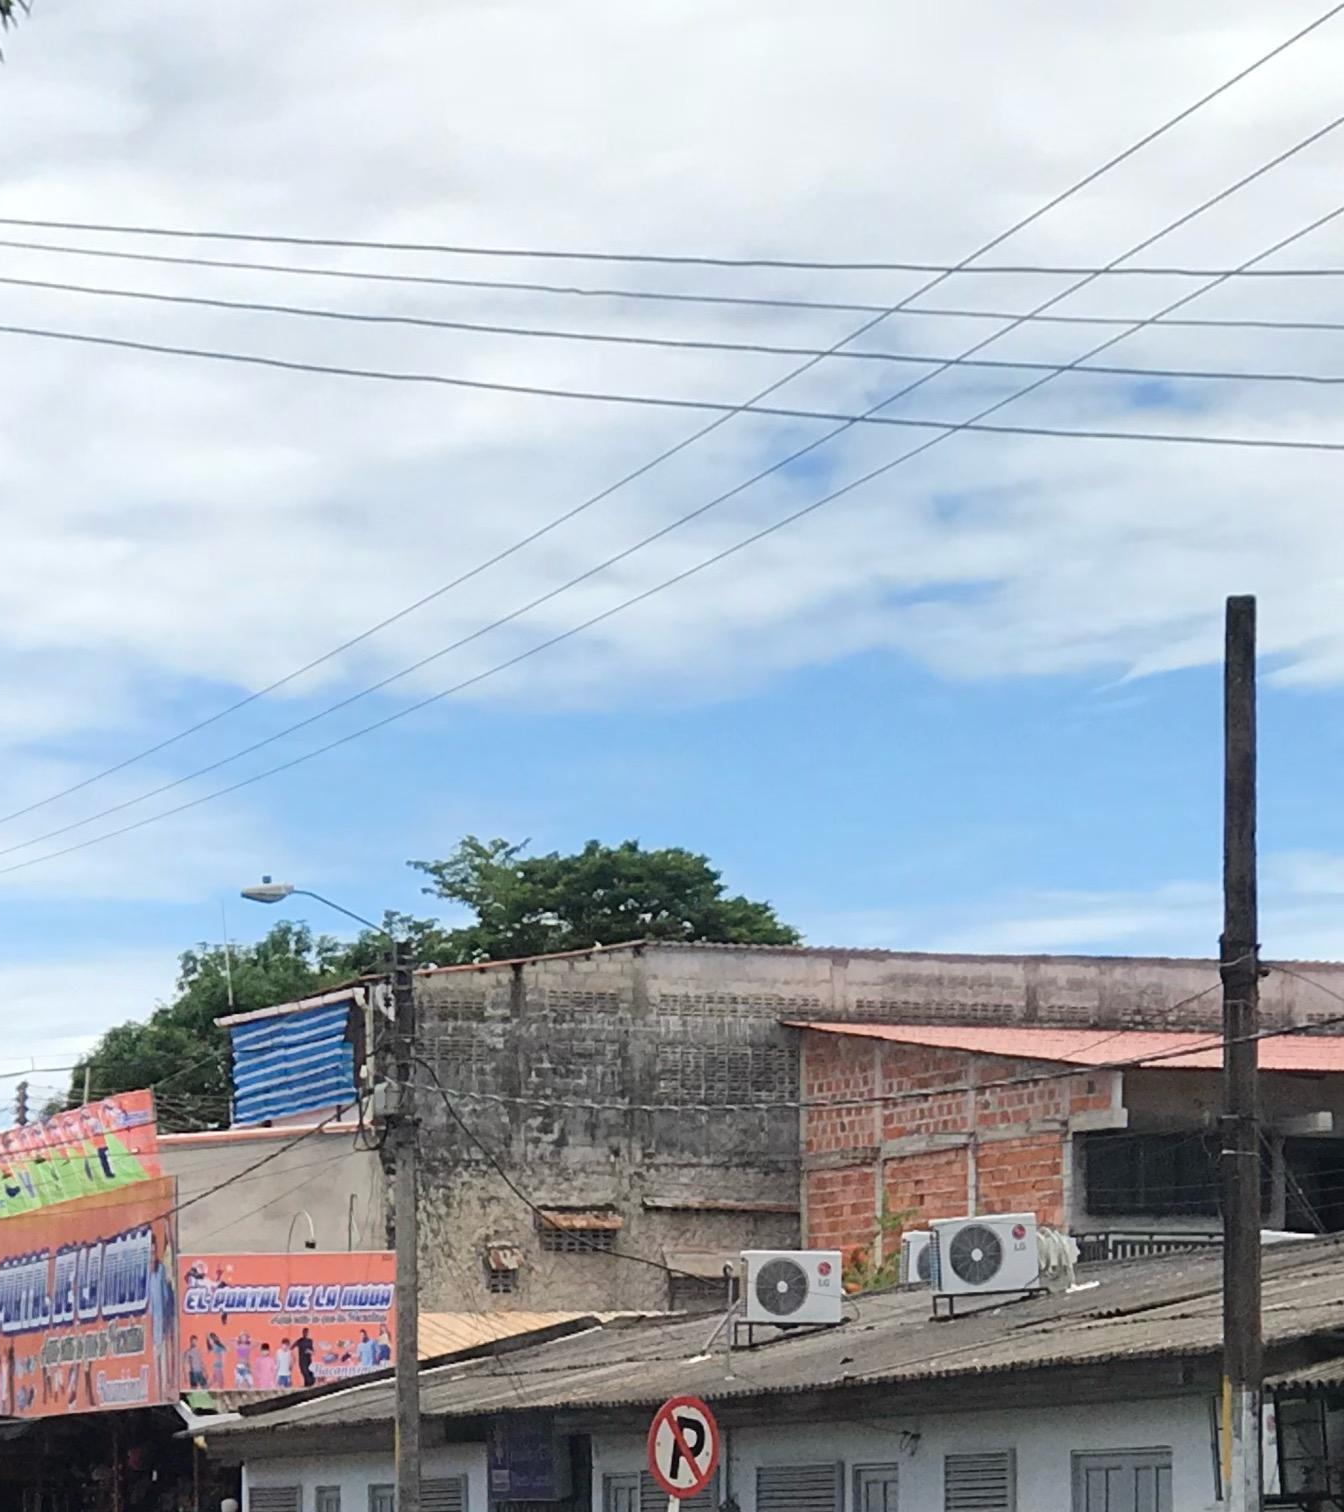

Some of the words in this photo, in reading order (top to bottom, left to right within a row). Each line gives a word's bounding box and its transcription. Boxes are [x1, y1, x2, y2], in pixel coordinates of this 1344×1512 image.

[1014, 1242, 1027, 1251] LG
[818, 1278, 831, 1287] LG
[184, 1286, 209, 1313] EL
[211, 1284, 283, 1313] PORTAL
[284, 1284, 314, 1312] DE
[313, 1283, 341, 1311] LA
[340, 1282, 395, 1310] MODA
[669, 1415, 705, 1480] P
